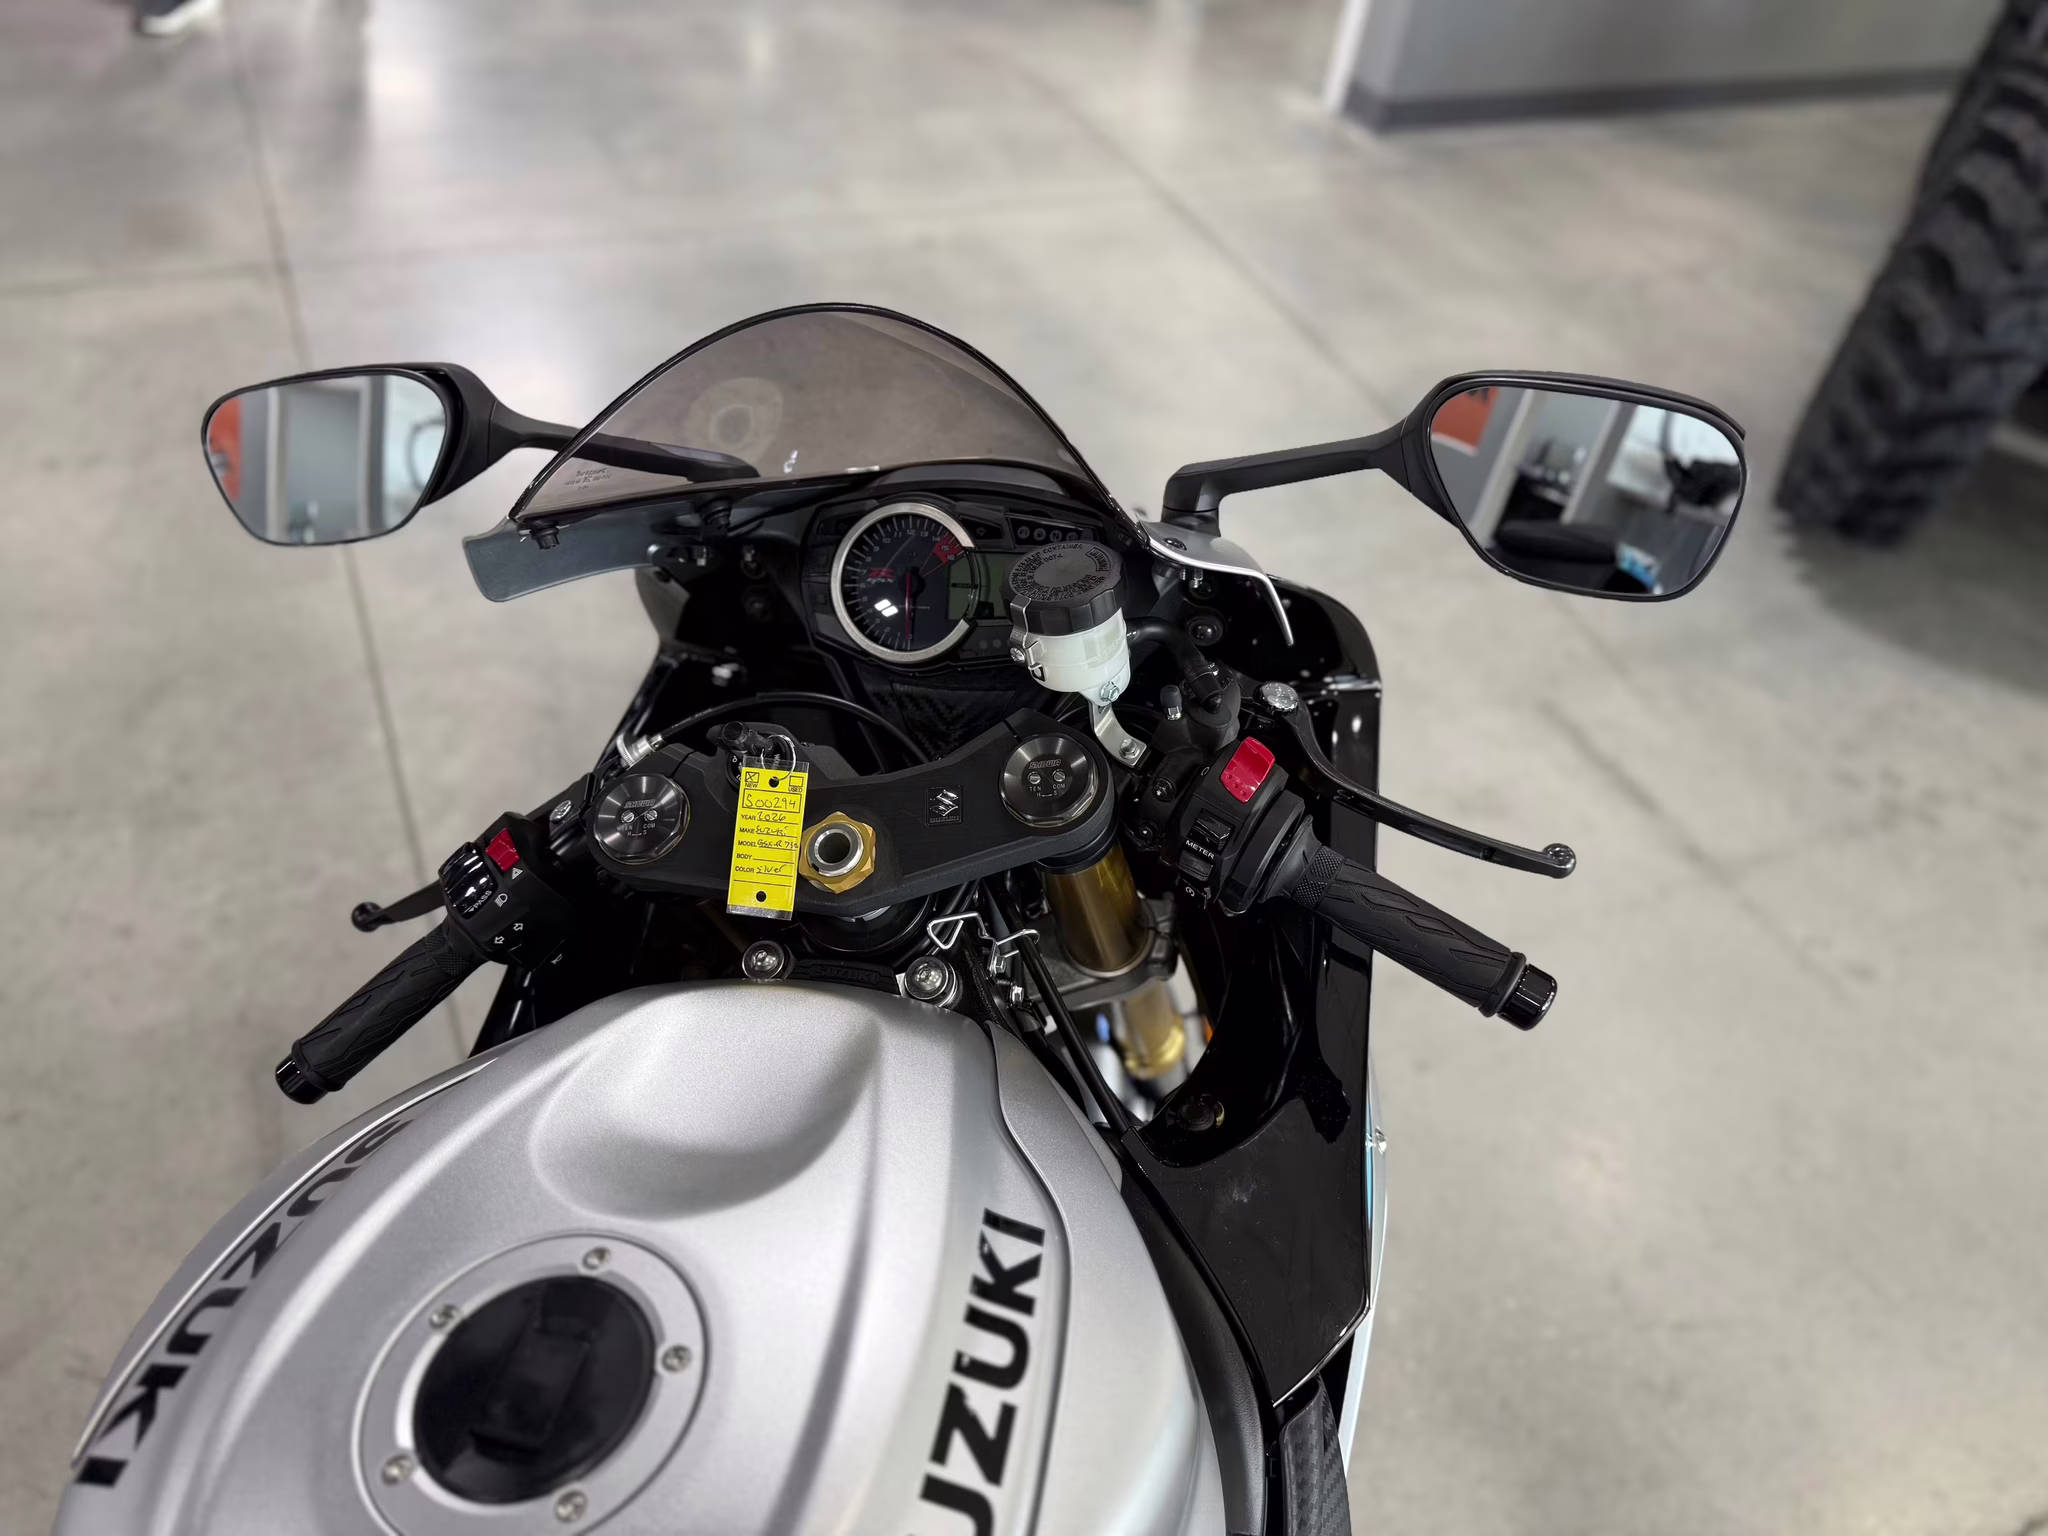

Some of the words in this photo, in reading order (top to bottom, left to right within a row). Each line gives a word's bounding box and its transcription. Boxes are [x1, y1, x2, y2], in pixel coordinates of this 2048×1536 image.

[738, 840, 757, 848] MODEL
[1186, 840, 1214, 859] METER
[473, 890, 493, 909] PASS
